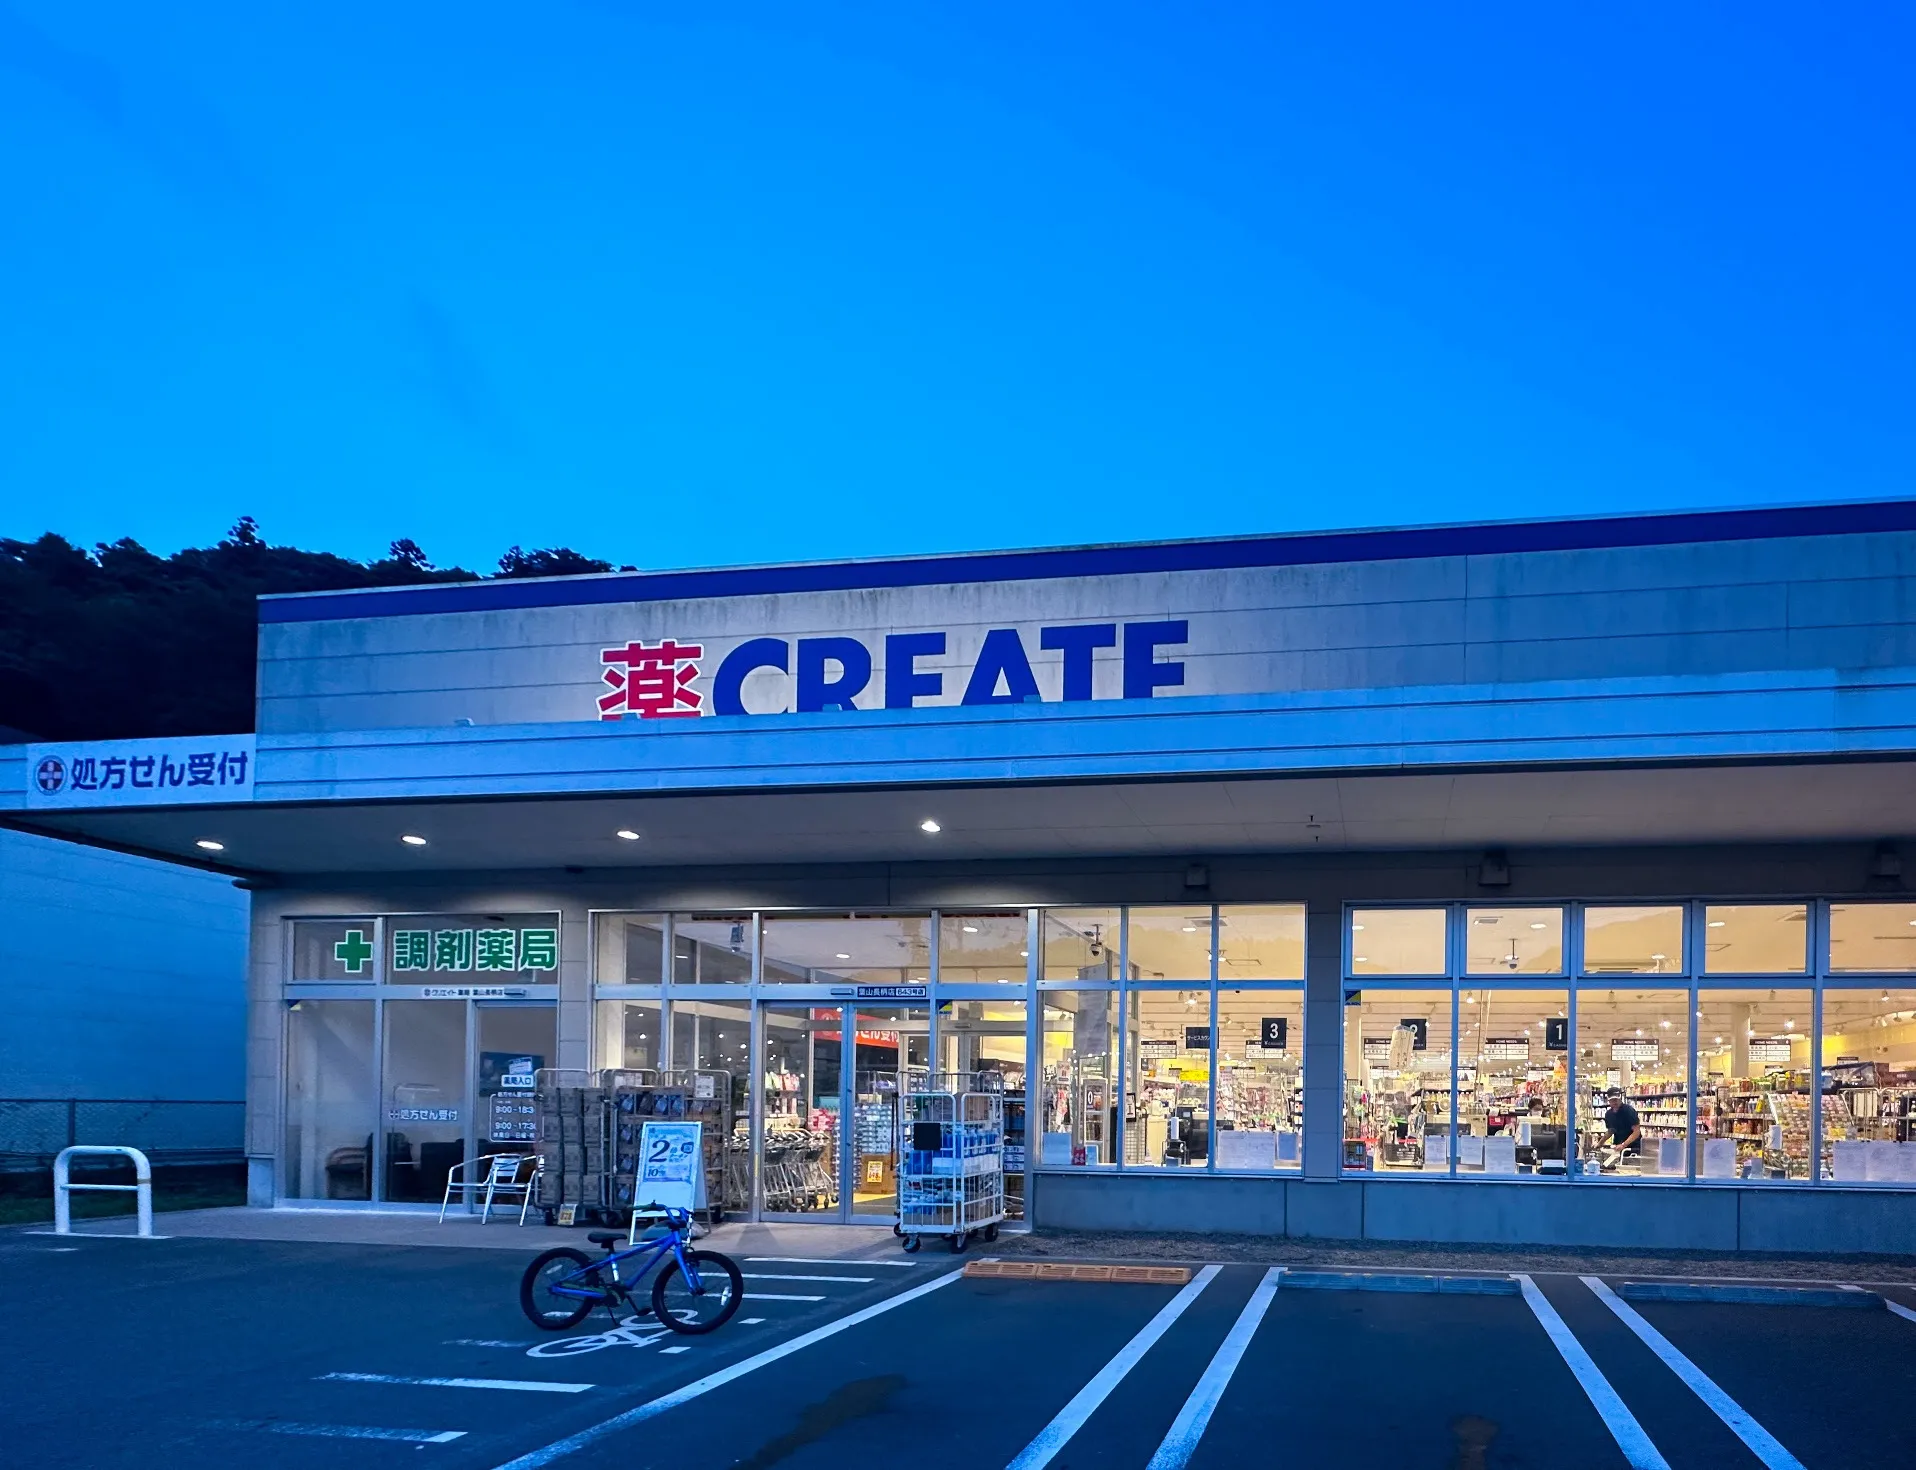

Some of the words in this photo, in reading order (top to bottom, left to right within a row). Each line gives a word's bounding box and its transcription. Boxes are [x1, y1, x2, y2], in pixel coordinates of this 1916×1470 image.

[598, 639, 702, 719] 薬
[713, 619, 1188, 716] CREATE
[71, 751, 248, 791] 処方せん受付
[394, 928, 557, 972] 調剤薬局
[1270, 1023, 1279, 1039] 3
[1555, 1024, 1563, 1040] 1
[400, 1110, 458, 1121] 処方せん受付
[649, 1140, 670, 1162] 2
